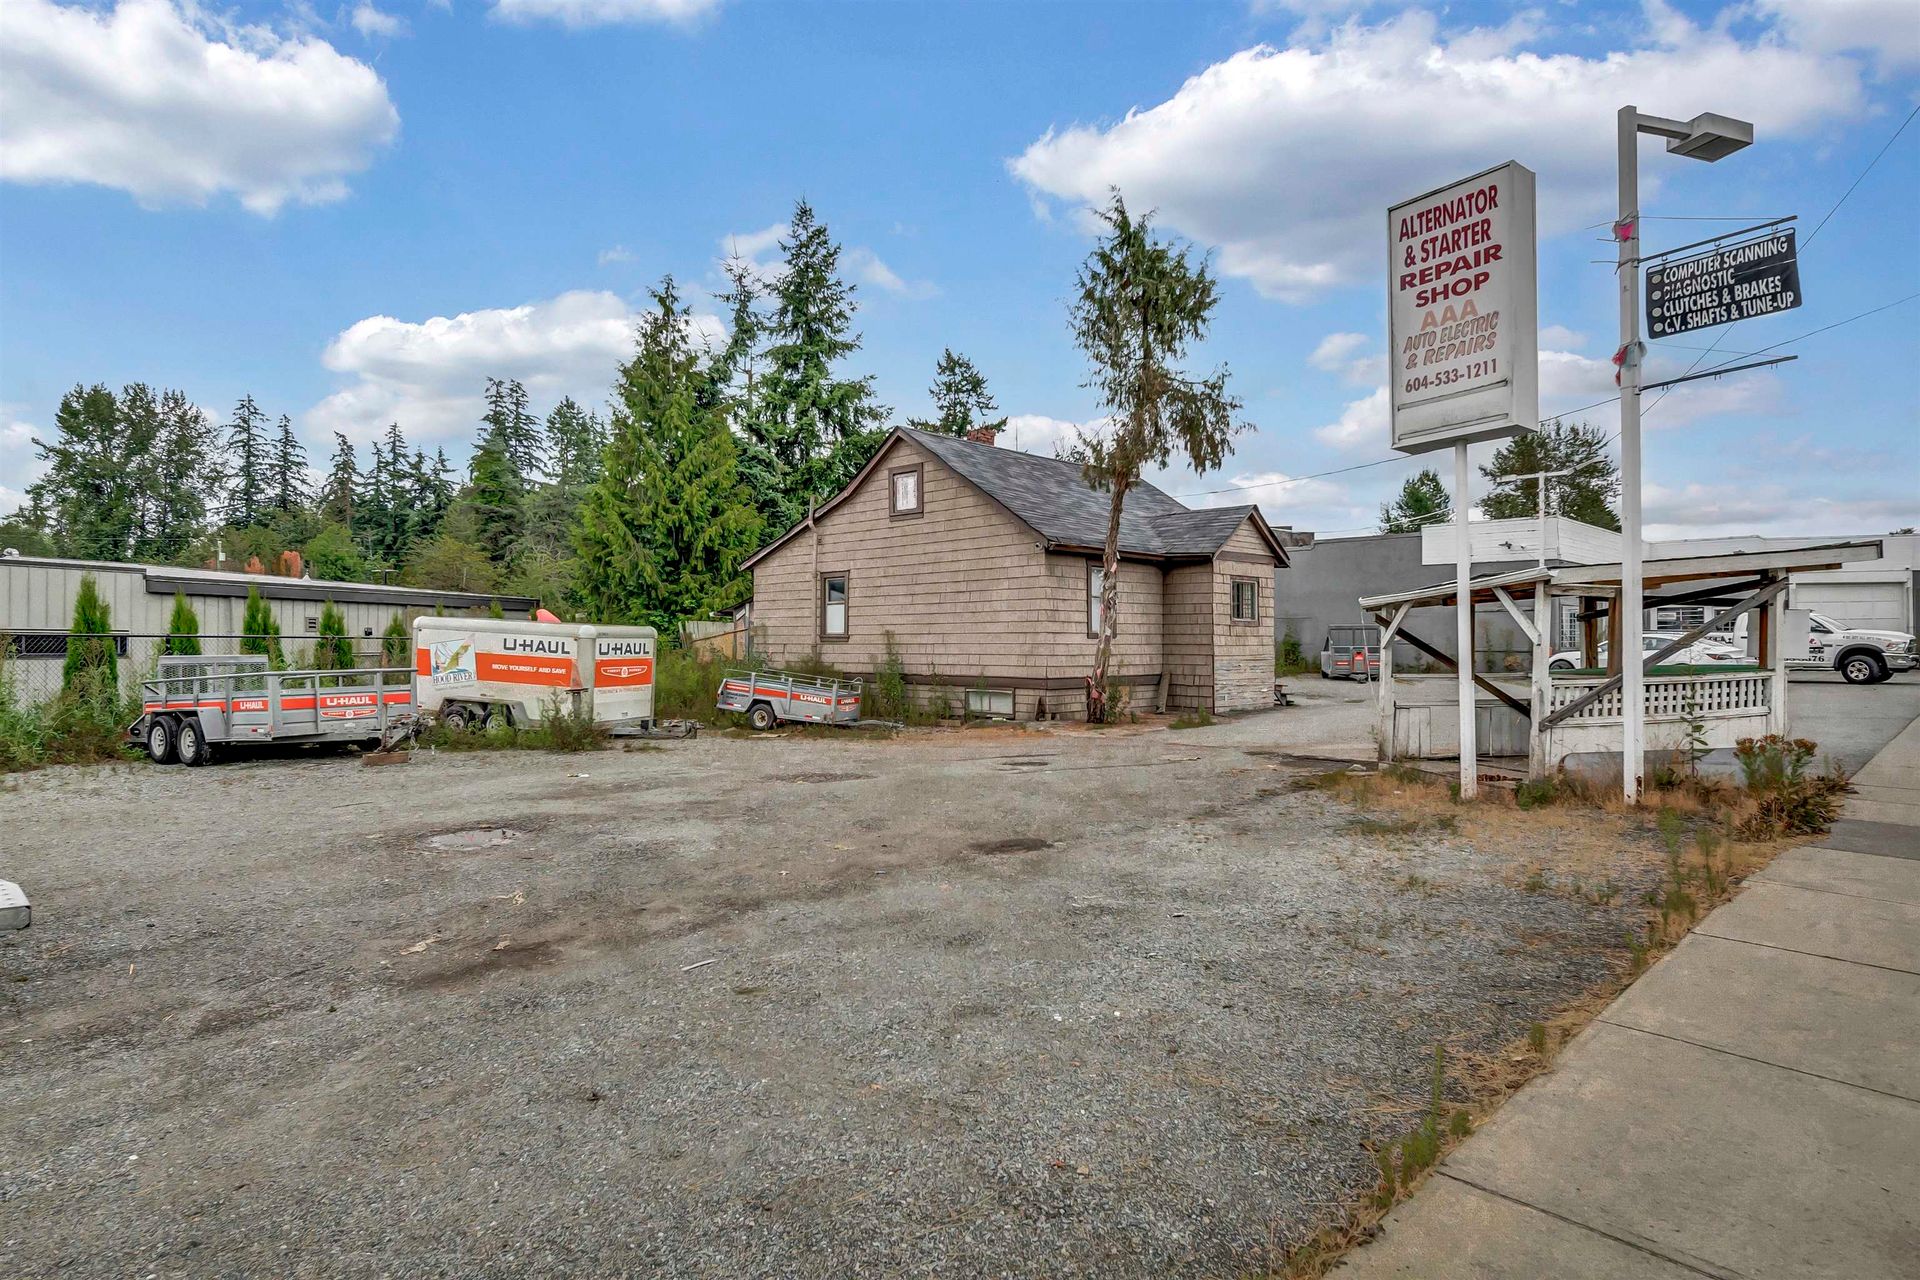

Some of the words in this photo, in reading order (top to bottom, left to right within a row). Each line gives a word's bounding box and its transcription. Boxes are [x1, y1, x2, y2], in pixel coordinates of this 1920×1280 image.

[1399, 184, 1498, 242] ALTERNATOR
[1404, 245, 1417, 268] &
[1421, 218, 1492, 263] STARTER
[1663, 255, 1721, 284] COMPUTER
[1723, 237, 1788, 266] SCANNING
[1400, 244, 1503, 291] REPAIR
[1664, 268, 1736, 300] DIAGNOSTIC
[1415, 271, 1490, 308] SHOP
[1663, 291, 1718, 317] CLUTCHES
[1722, 288, 1731, 304] &
[1734, 275, 1782, 302] BRAKES
[1421, 299, 1479, 332] AAA
[1664, 316, 1686, 334] C.V.
[1687, 305, 1728, 329] SHAFTS
[1730, 303, 1740, 319] &
[1741, 291, 1795, 317] TUNE-UP
[1403, 331, 1437, 354] AUTO
[1440, 311, 1499, 344] ELECTRIC
[1405, 353, 1418, 370] &
[1423, 332, 1497, 366] REPAIRS
[1405, 358, 1497, 393] 604-533-1211
[503, 638, 570, 655] U-HAUL
[599, 643, 650, 656] U-HAUL
[433, 674, 452, 684] HOOD
[453, 671, 473, 683] RIVER
[491, 663, 509, 671] MOVE
[508, 665, 538, 673] YOURSELF
[551, 667, 567, 675] SAVE
[240, 701, 265, 710] U-HAUL
[326, 696, 373, 706] U-HAUL
